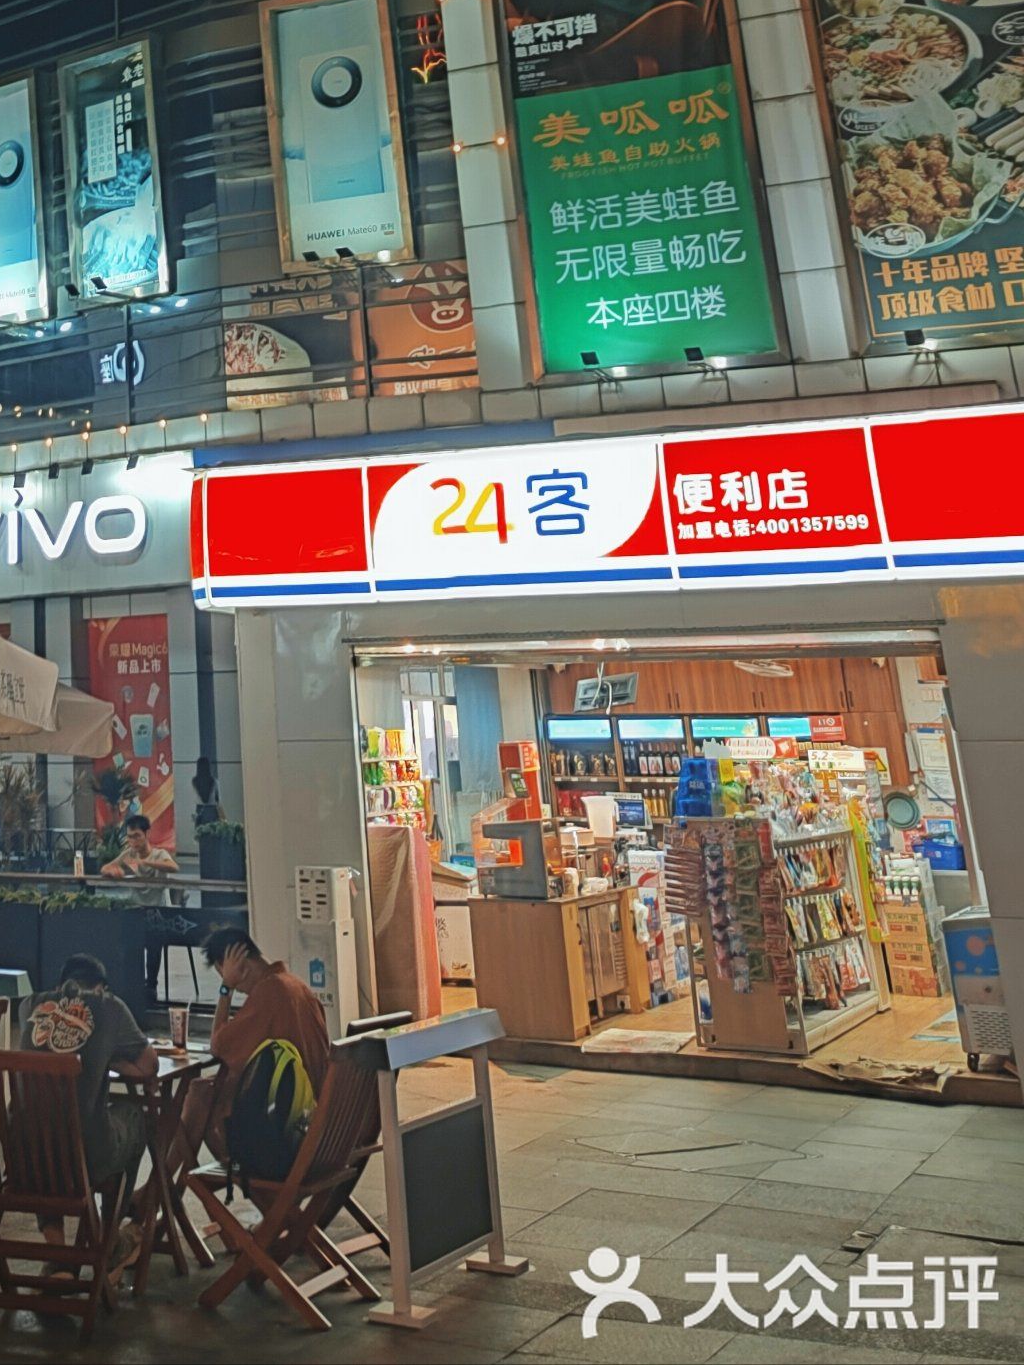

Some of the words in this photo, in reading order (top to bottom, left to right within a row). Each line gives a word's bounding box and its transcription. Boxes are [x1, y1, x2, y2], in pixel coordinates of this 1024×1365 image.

[532, 89, 729, 148] 美呱呱
[549, 179, 740, 234] 鲜活美蛙鱼
[307, 228, 345, 242] HUAWEI
[347, 224, 378, 236] Mate60
[555, 229, 747, 284] 无限量畅吃
[873, 250, 988, 288] 十年品牌
[585, 284, 727, 330] 本座四楼
[878, 283, 996, 321] 顶级食材
[673, 468, 809, 515] 便利店
[677, 513, 869, 540] 加盟电话:4001357599
[117, 658, 162, 674] 新品上市
